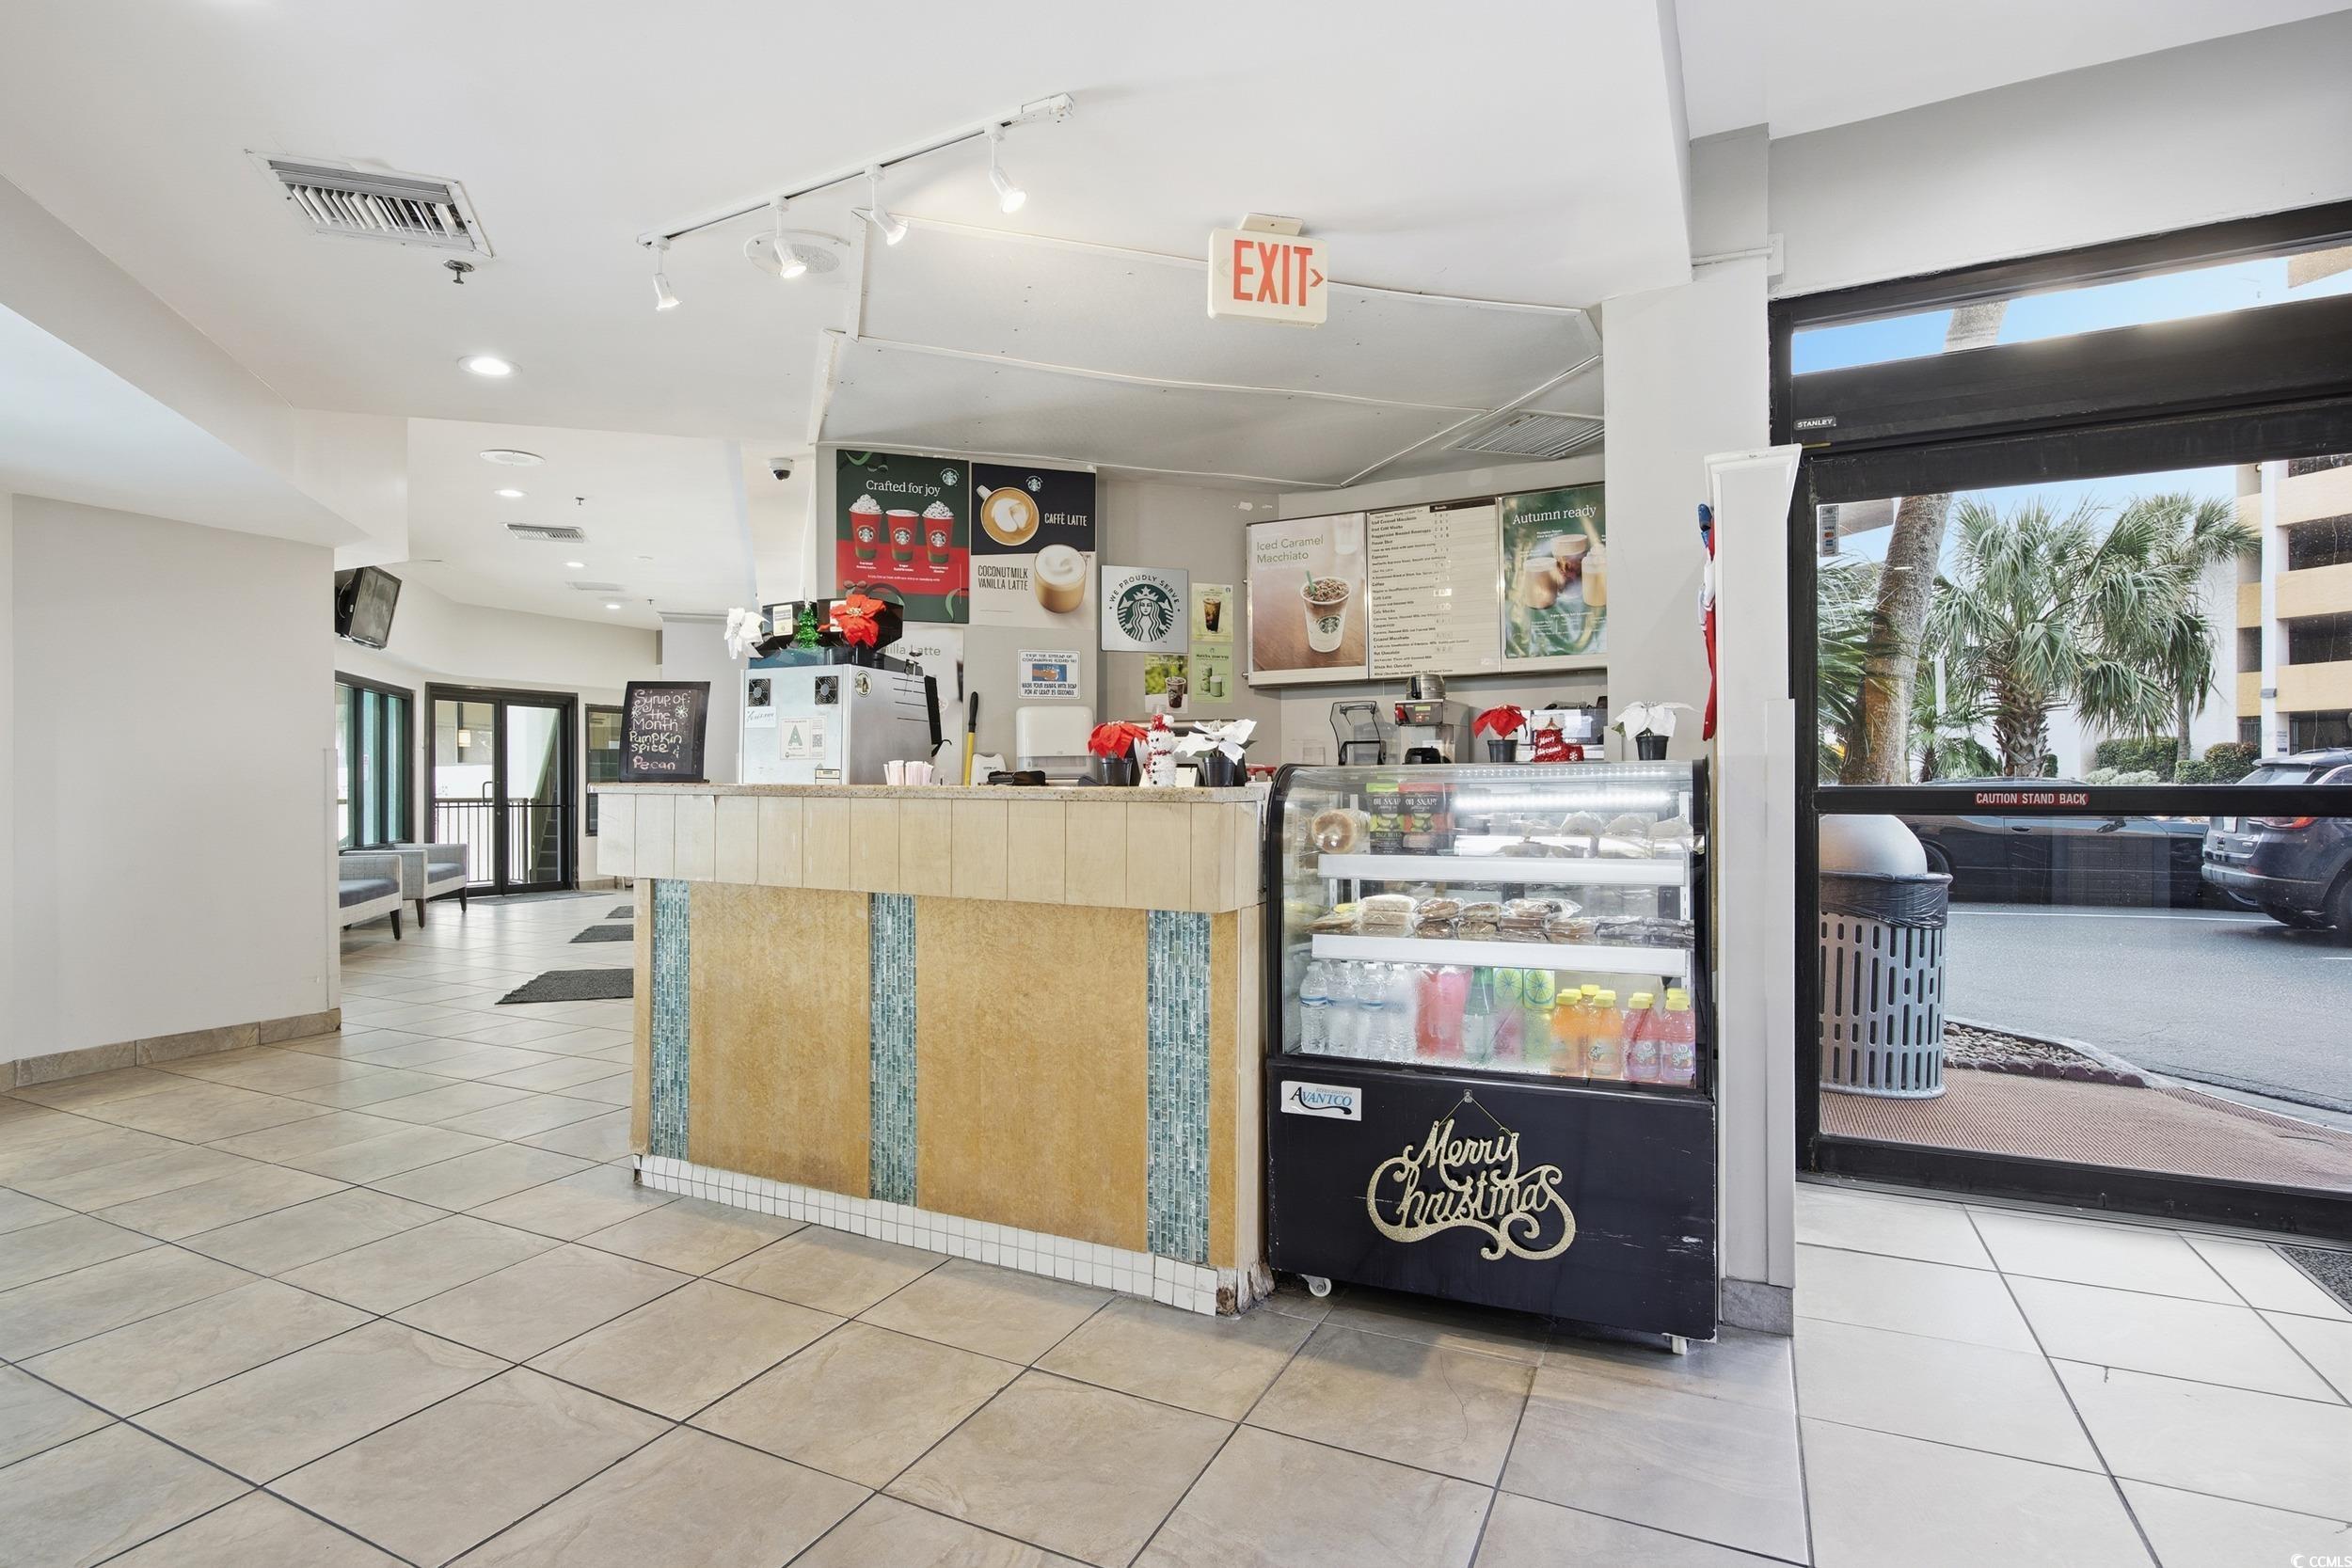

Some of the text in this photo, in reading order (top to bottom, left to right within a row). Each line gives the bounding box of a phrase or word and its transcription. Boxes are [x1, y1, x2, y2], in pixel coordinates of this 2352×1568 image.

[1233, 240, 1312, 307] EXIT
[1797, 418, 1833, 428] STANLEY
[866, 480, 941, 497] Crafted for joy
[1044, 512, 1088, 527] CAFFÈ LATTE
[1513, 505, 1597, 525] Autumn ready
[1257, 533, 1324, 551] Iced Caramel
[1257, 551, 1309, 564] Macchiato
[977, 565, 1028, 578] COCONUTMILK
[978, 578, 1028, 591] VANILLA LATTE
[1109, 575, 1180, 604] WE PROUDLY SERVE
[634, 689, 671, 713] Syrup
[646, 708, 671, 721] the
[632, 718, 678, 732] Month
[788, 724, 803, 746] A
[631, 743, 669, 754] spice
[633, 755, 675, 770] Pecan
[1976, 793, 2087, 805] CAUTION STAND BACK
[1290, 1086, 1353, 1108] AVANTCO
[1403, 1118, 1520, 1190] Merry
[1366, 1157, 1576, 1260] Christmas
